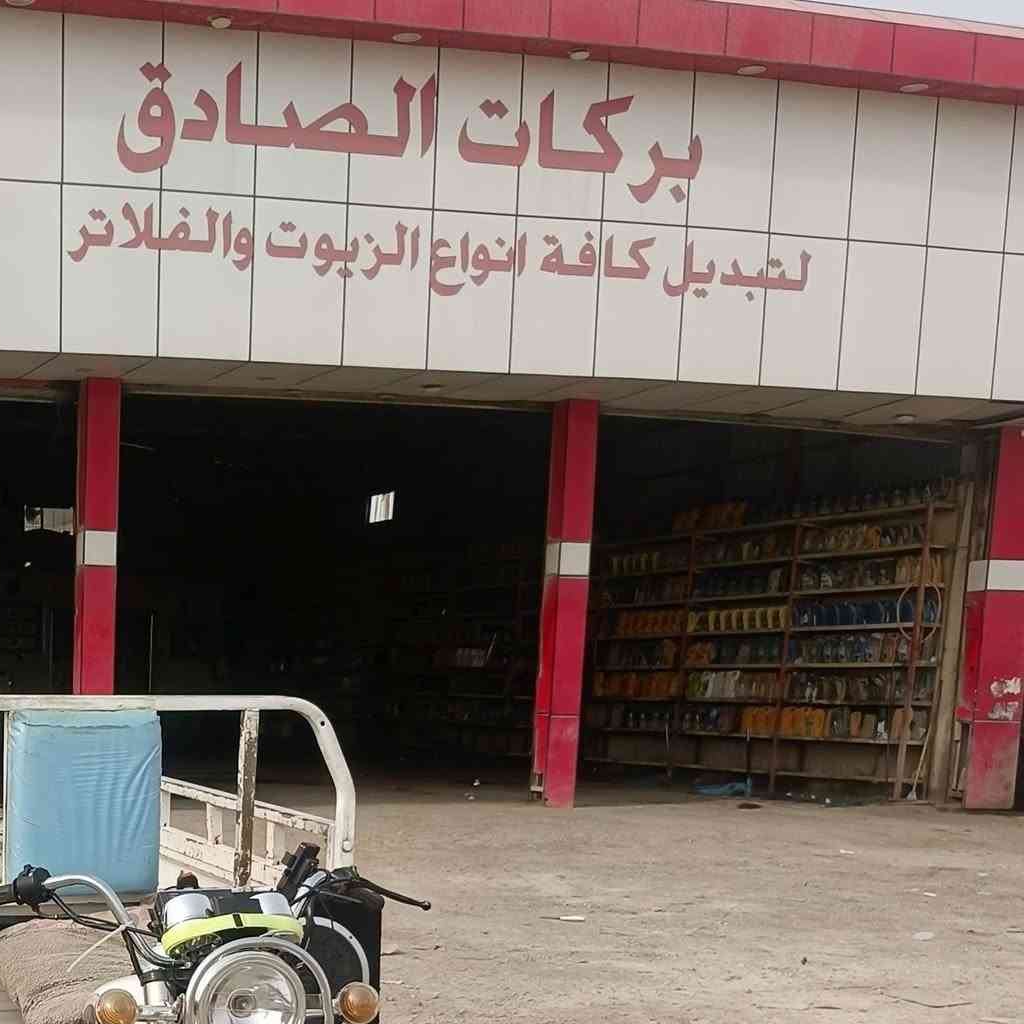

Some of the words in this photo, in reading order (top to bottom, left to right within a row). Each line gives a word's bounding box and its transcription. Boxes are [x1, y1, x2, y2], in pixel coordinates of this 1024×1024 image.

[116, 61, 438, 172] الصادق
[457, 90, 703, 204] بركات
[67, 202, 255, 271] والفلاتر
[265, 219, 420, 281] الزيوت
[429, 232, 527, 297] انواع
[539, 233, 657, 287] كافة
[662, 242, 812, 301] لتبديل
